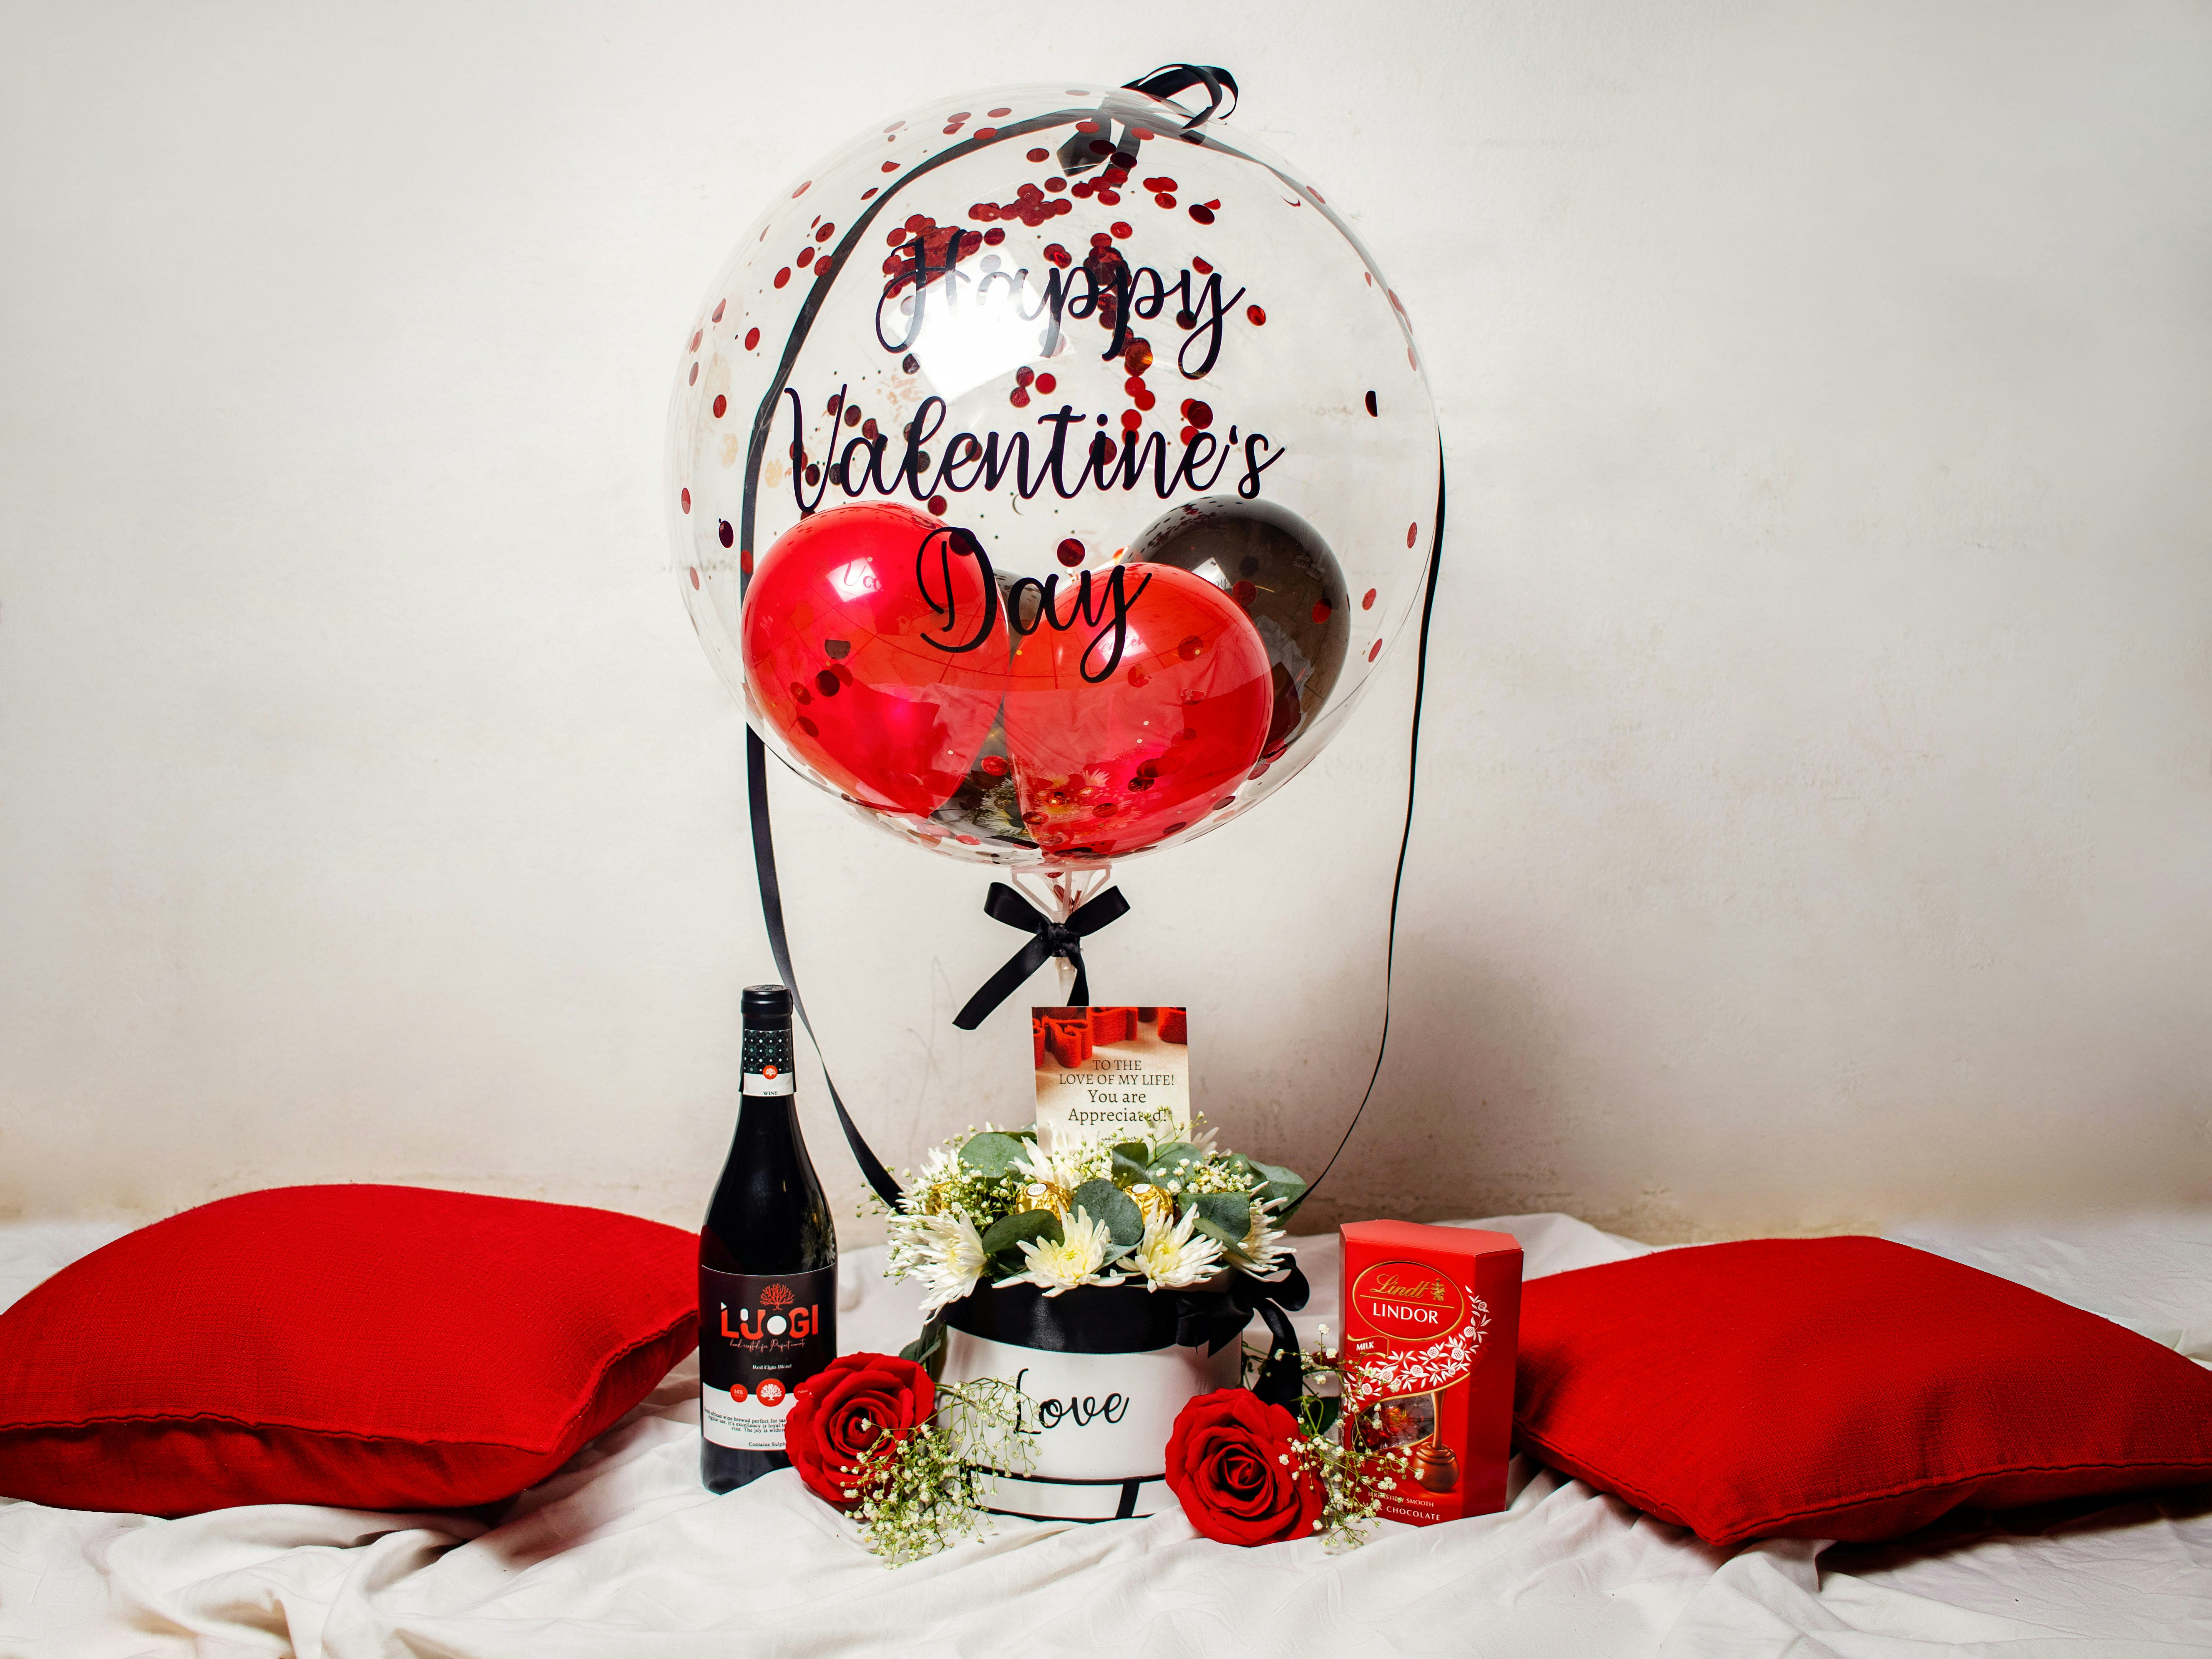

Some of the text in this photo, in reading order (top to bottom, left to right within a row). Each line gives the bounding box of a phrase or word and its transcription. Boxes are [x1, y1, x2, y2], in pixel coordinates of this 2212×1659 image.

[876, 229, 1246, 379] Happy
[785, 384, 1285, 513] Valentine's
[916, 526, 1152, 683] Day
[1093, 1060, 1142, 1070] TO THE
[1059, 1074, 1174, 1085] LOVE OF MY LIFE!
[1088, 1090, 1146, 1103] You are
[1370, 1274, 1431, 1298] Lindt
[721, 1301, 818, 1340] LUOGI
[1373, 1302, 1438, 1324] LINDOR
[1356, 1341, 1374, 1351] MILK
[1013, 1368, 1129, 1435] Love
[1386, 1506, 1440, 1521] CHOCOLATE
[1406, 1498, 1434, 1507] SMOOTH
